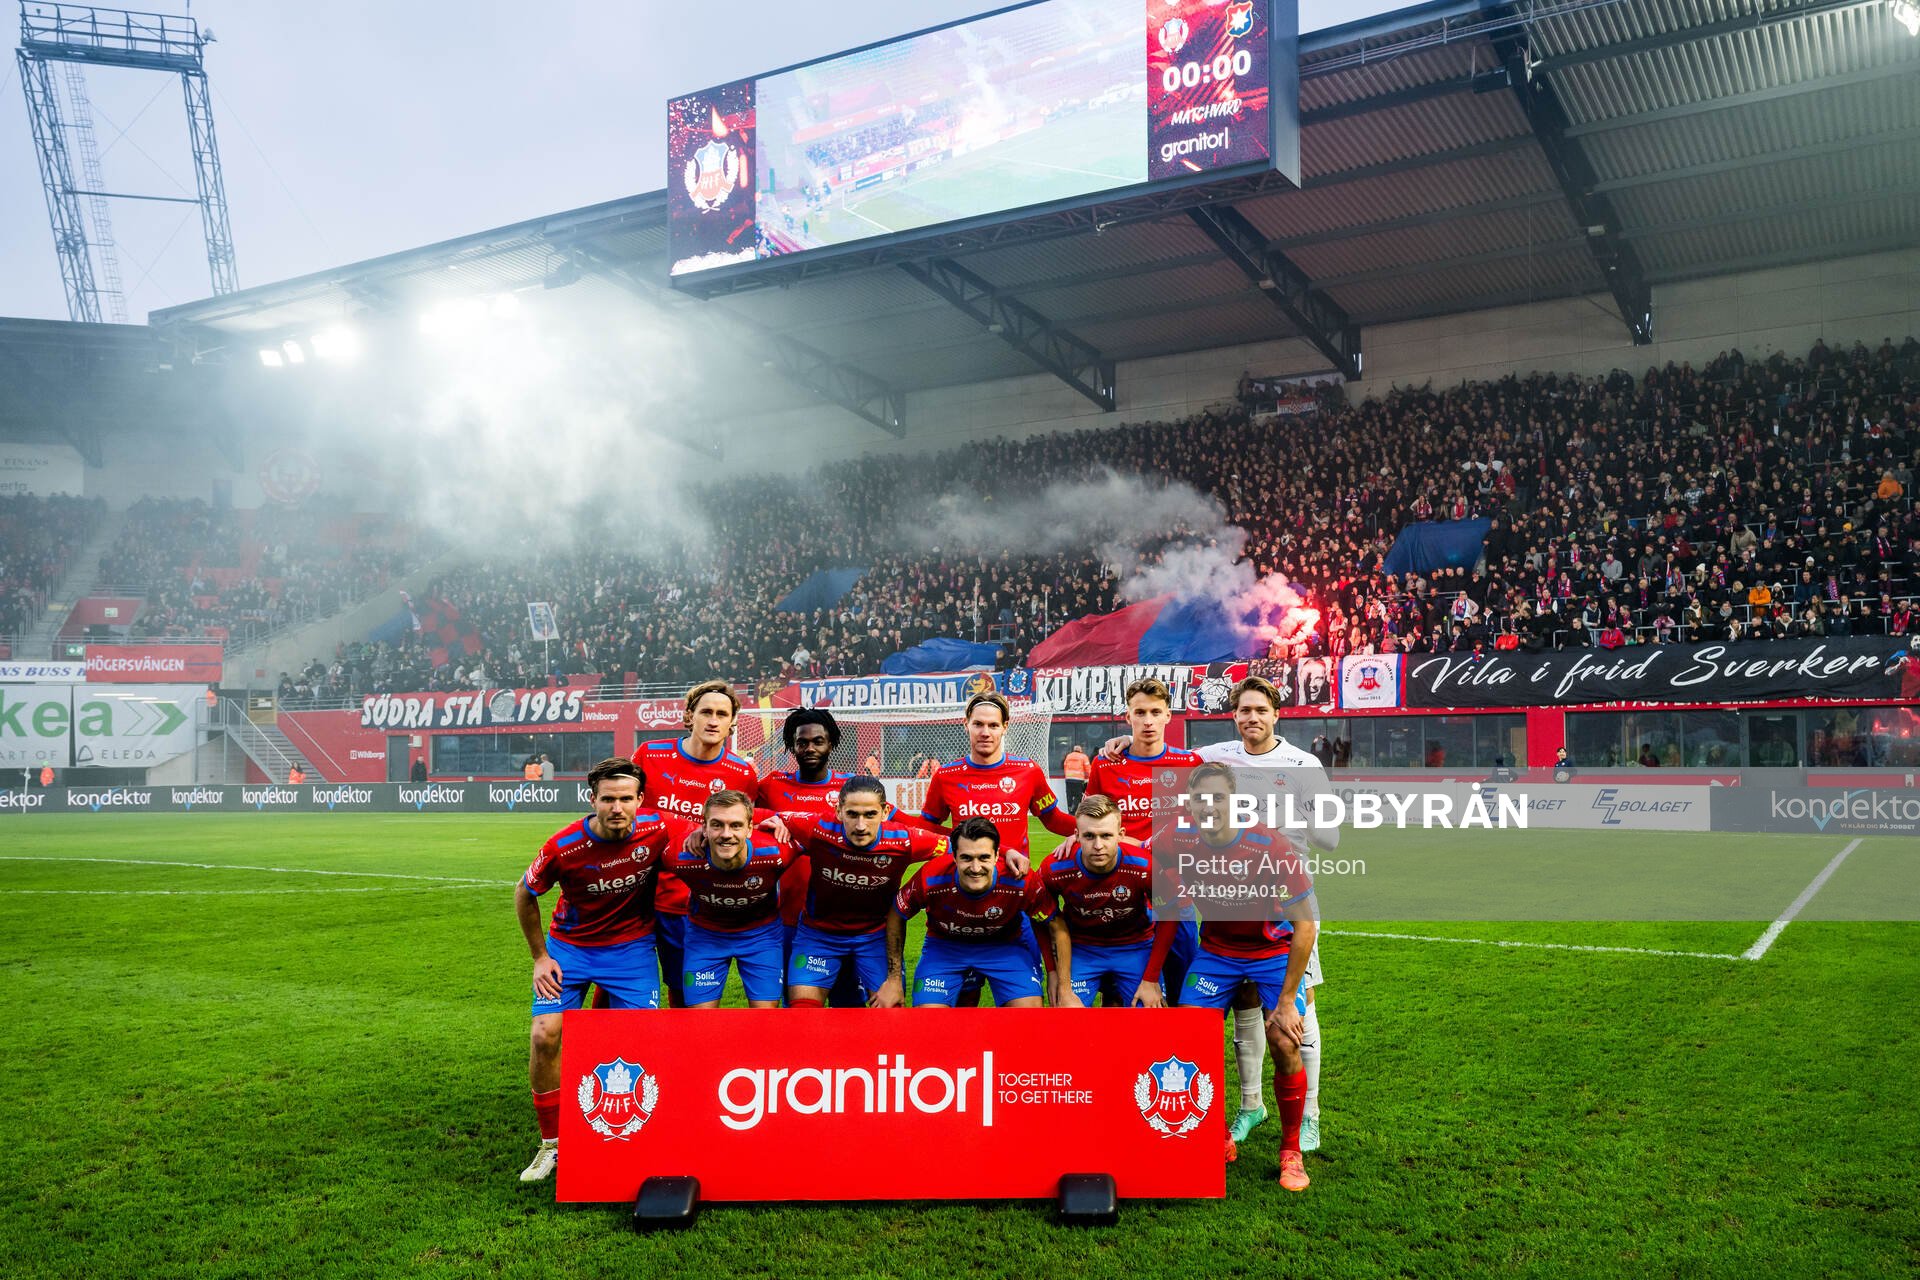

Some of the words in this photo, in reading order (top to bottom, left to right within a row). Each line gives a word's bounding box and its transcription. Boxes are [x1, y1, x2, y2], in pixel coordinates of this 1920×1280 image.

[1162, 50, 1252, 91] 00:00
[1160, 131, 1224, 163] granitor
[25, 666, 72, 677] BUSS
[86, 655, 185, 672] HÖGERSVÄNGEN
[1411, 654, 1517, 694] Vila
[1530, 661, 1552, 683] i
[1553, 650, 1664, 699] frid
[1669, 644, 1881, 687] Sverker
[361, 693, 435, 729] SÖDRA
[439, 689, 486, 727] STÅ
[517, 689, 585, 722] 1985
[584, 711, 619, 723] Wihlborgs
[638, 702, 684, 727] Carlsberg
[35, 750, 57, 761] OF
[101, 749, 157, 760] ELEDA
[67, 789, 152, 806] kondektor
[171, 788, 224, 804] kondektor
[242, 786, 299, 804] kondektor
[312, 785, 373, 803] kondektor
[398, 785, 465, 803] kondektor
[489, 783, 560, 802] kondektor
[657, 793, 704, 816] akea
[958, 800, 1002, 817] akea
[1036, 792, 1055, 811] XXL
[1117, 794, 1161, 811] akea
[1618, 801, 1693, 813] BOLAGET
[1771, 790, 1920, 820] kondekto
[586, 874, 636, 892] akea
[822, 867, 870, 887] akea
[808, 956, 827, 967] Solid
[695, 971, 715, 980] Solid
[924, 978, 945, 988] Solid
[1198, 977, 1219, 993] Solid
[998, 1072, 1072, 1087] TOGETHER
[718, 1053, 977, 1131] granitor
[998, 1090, 1019, 1104] TO
[1021, 1090, 1052, 1104] GET
[1051, 1090, 1093, 1104] THERE
